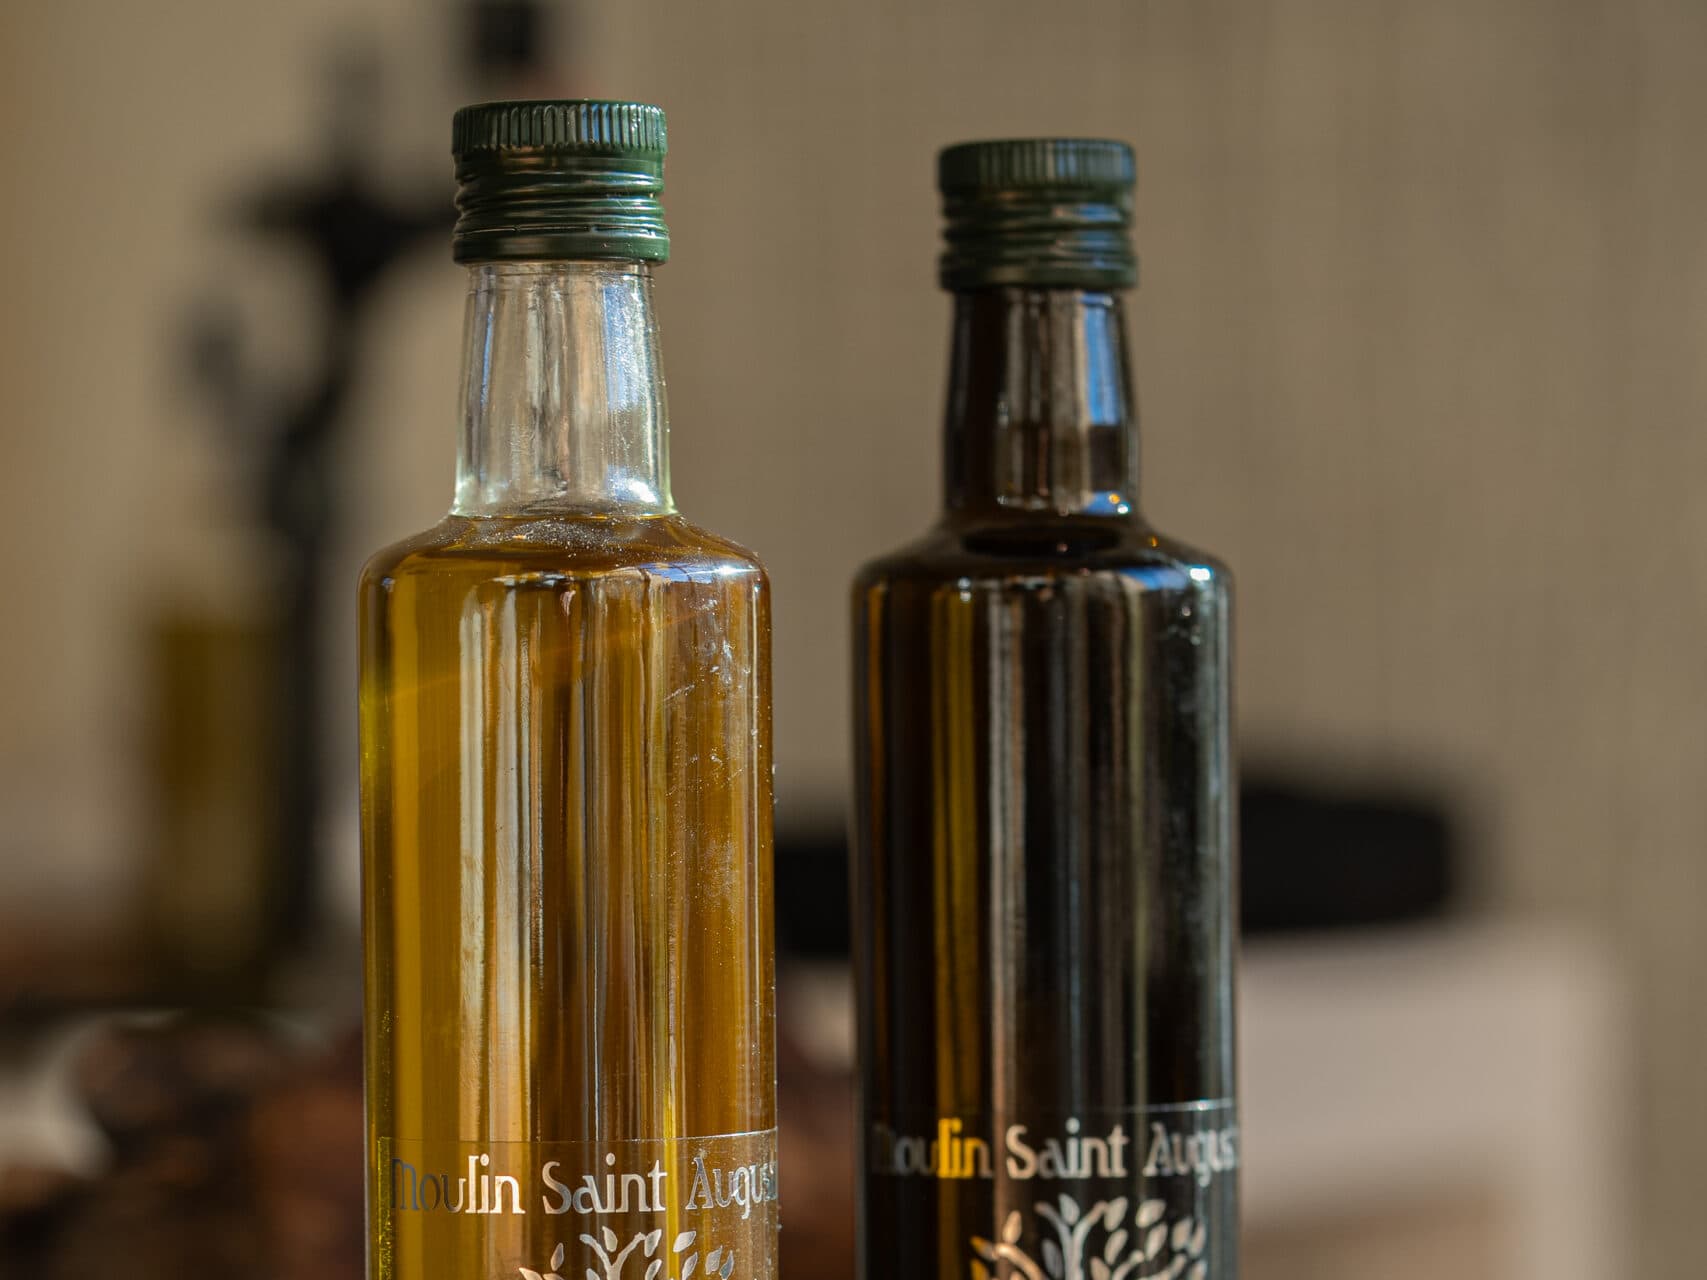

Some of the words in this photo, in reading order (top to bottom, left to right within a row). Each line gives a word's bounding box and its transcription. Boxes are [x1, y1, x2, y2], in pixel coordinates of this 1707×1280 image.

[1005, 1117, 1129, 1179] Saint
[391, 1152, 525, 1214] Moulin
[542, 1152, 667, 1214] Saint
